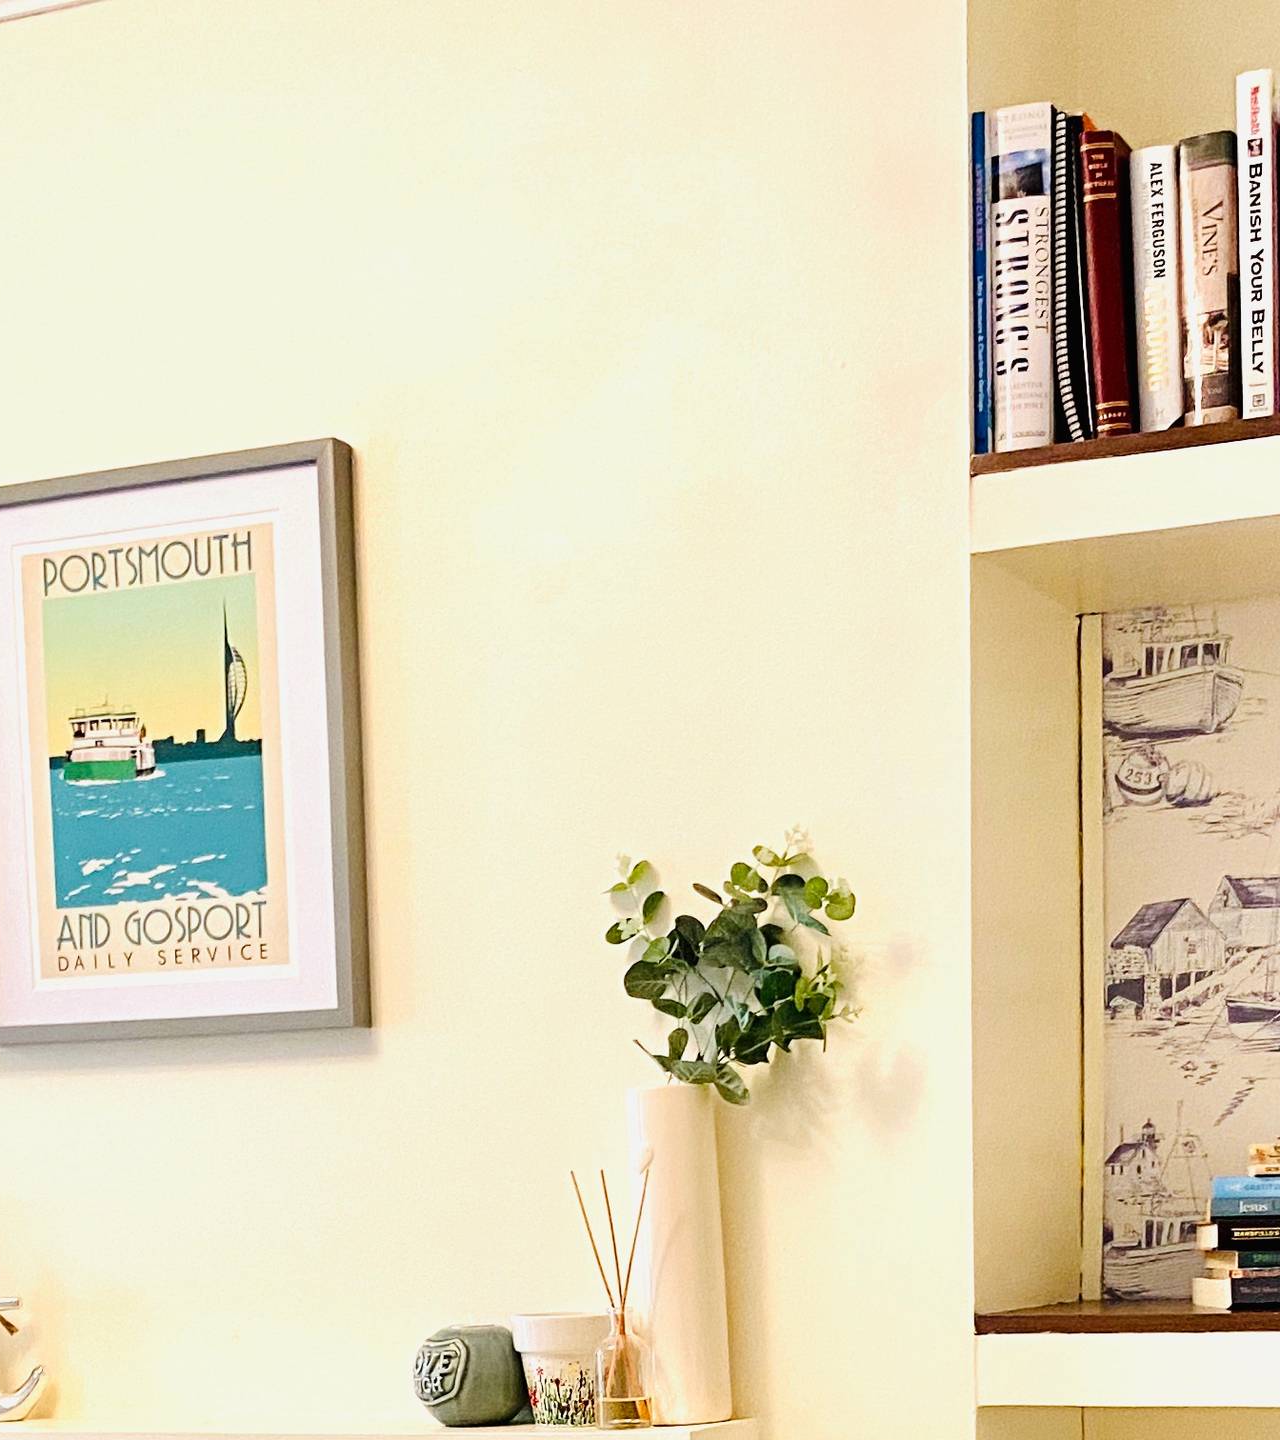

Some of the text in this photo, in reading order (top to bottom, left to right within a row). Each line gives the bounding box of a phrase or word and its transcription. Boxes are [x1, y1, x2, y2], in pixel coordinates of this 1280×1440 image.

[1150, 162, 1167, 279] ALEX FERGUSON
[1201, 200, 1224, 277] VINE'S
[995, 208, 1030, 377] STRONG'S
[1034, 206, 1050, 334] STRONGEST
[1248, 162, 1266, 374] BANISH YOUR BELLY
[42, 530, 253, 597] PORTSMOUTH
[56, 899, 269, 952] AND GOSPORT
[57, 942, 270, 973] DAILY SERVICE
[1239, 1200, 1268, 1213] Jesus
